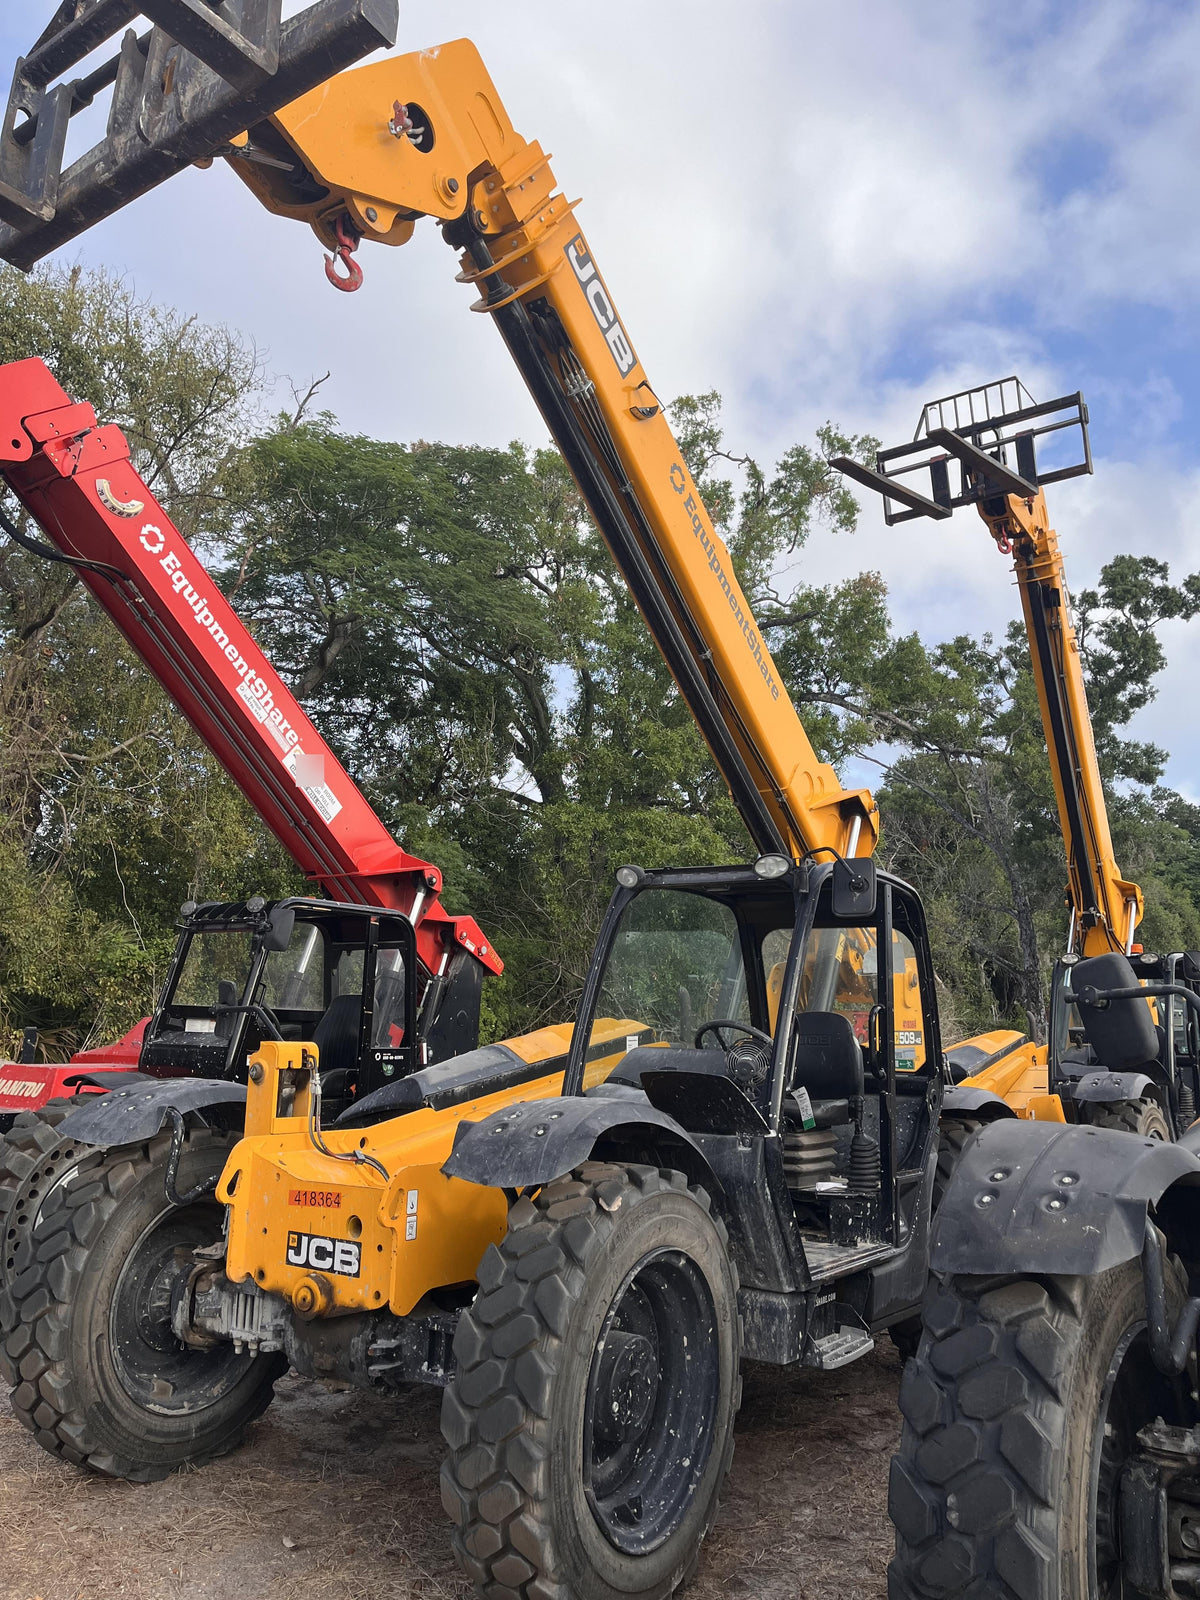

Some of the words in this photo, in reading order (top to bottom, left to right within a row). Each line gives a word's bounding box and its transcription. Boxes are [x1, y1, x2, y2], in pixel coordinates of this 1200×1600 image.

[568, 244, 633, 373] JCB
[159, 551, 298, 745] EquipmentShare
[683, 493, 779, 701] EquipmentShare
[288, 1235, 359, 1274] JCB
[294, 1191, 341, 1207] 418364
